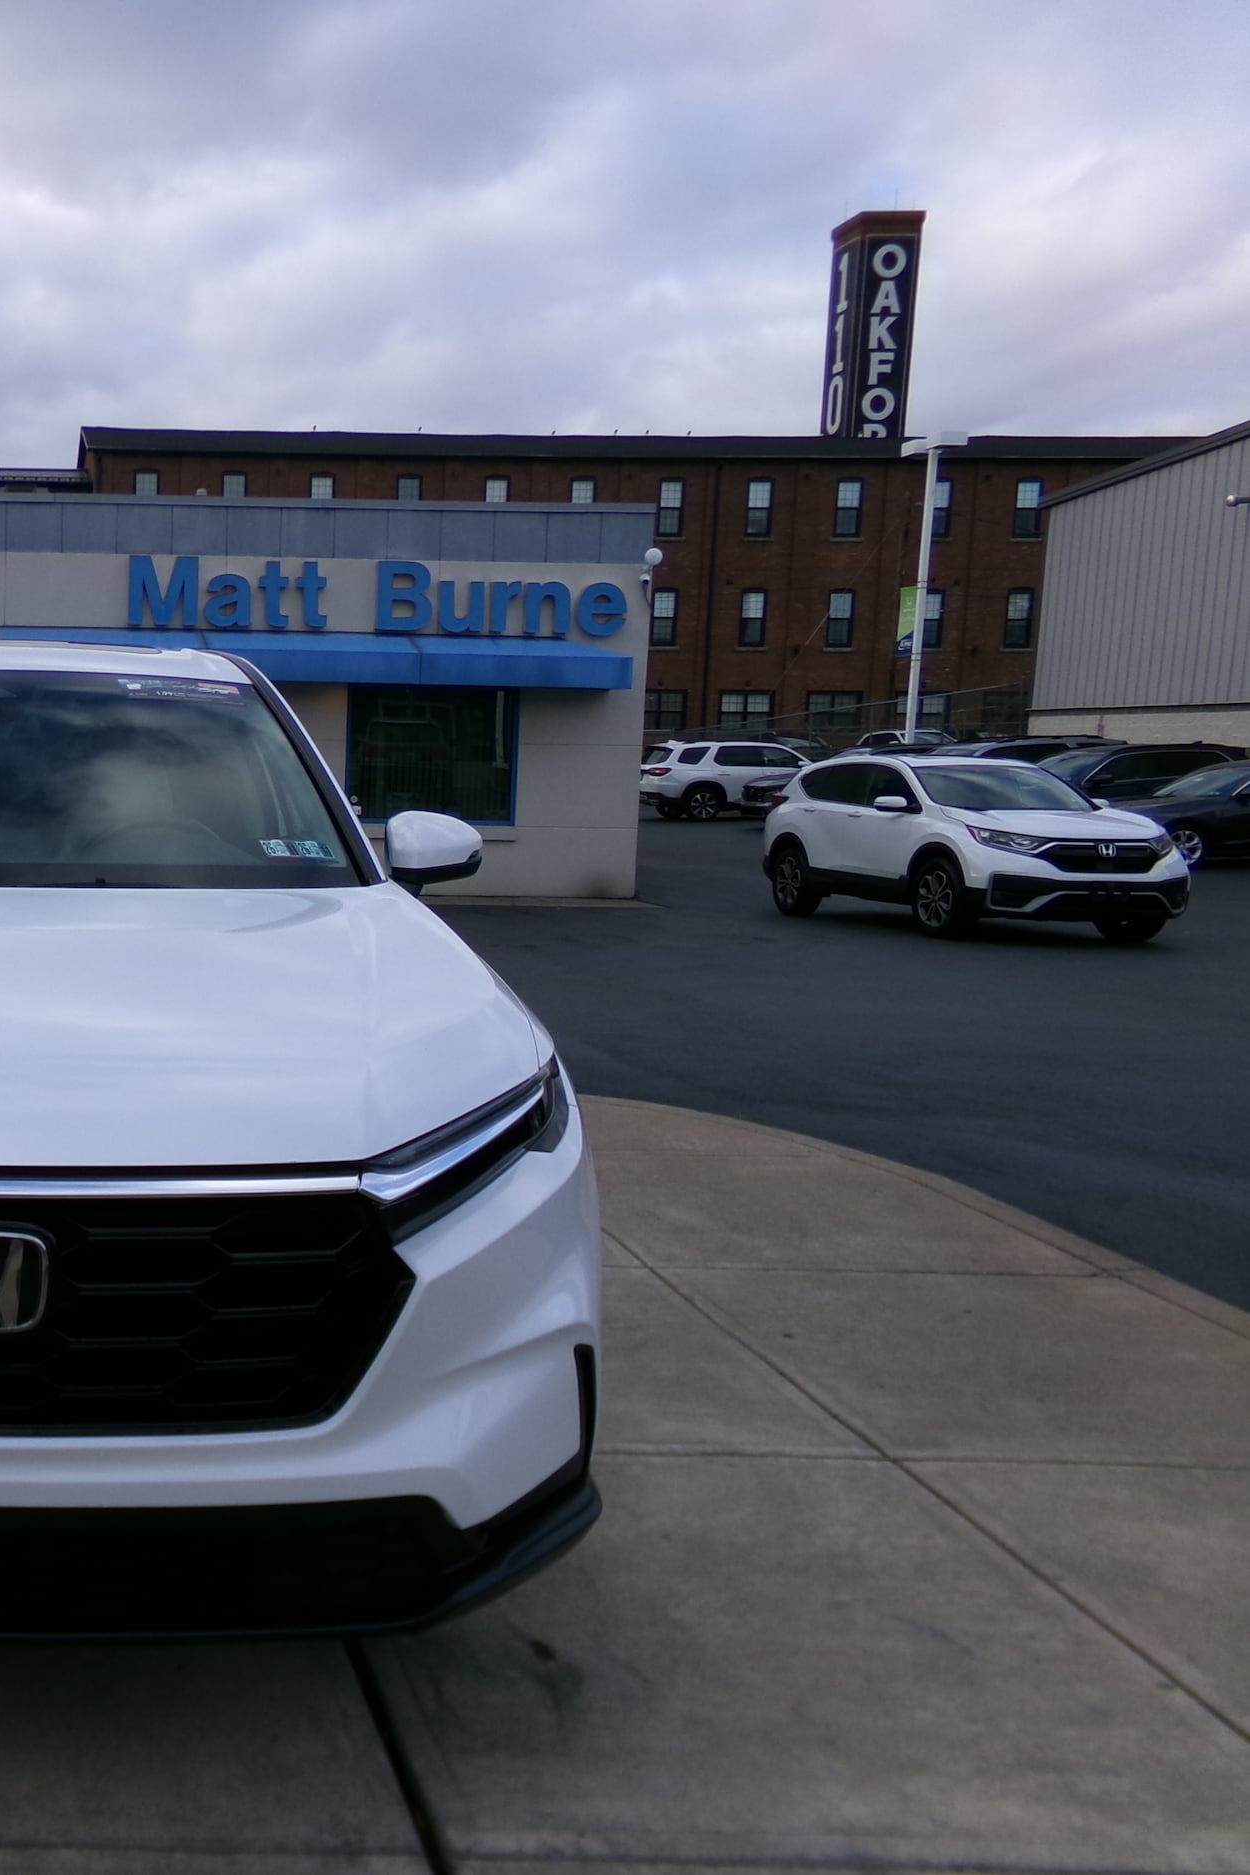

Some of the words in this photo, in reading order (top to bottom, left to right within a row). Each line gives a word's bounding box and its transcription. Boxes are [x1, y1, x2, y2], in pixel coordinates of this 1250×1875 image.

[826, 251, 849, 435] 110
[127, 554, 328, 629] Matt
[374, 560, 628, 637] Burne
